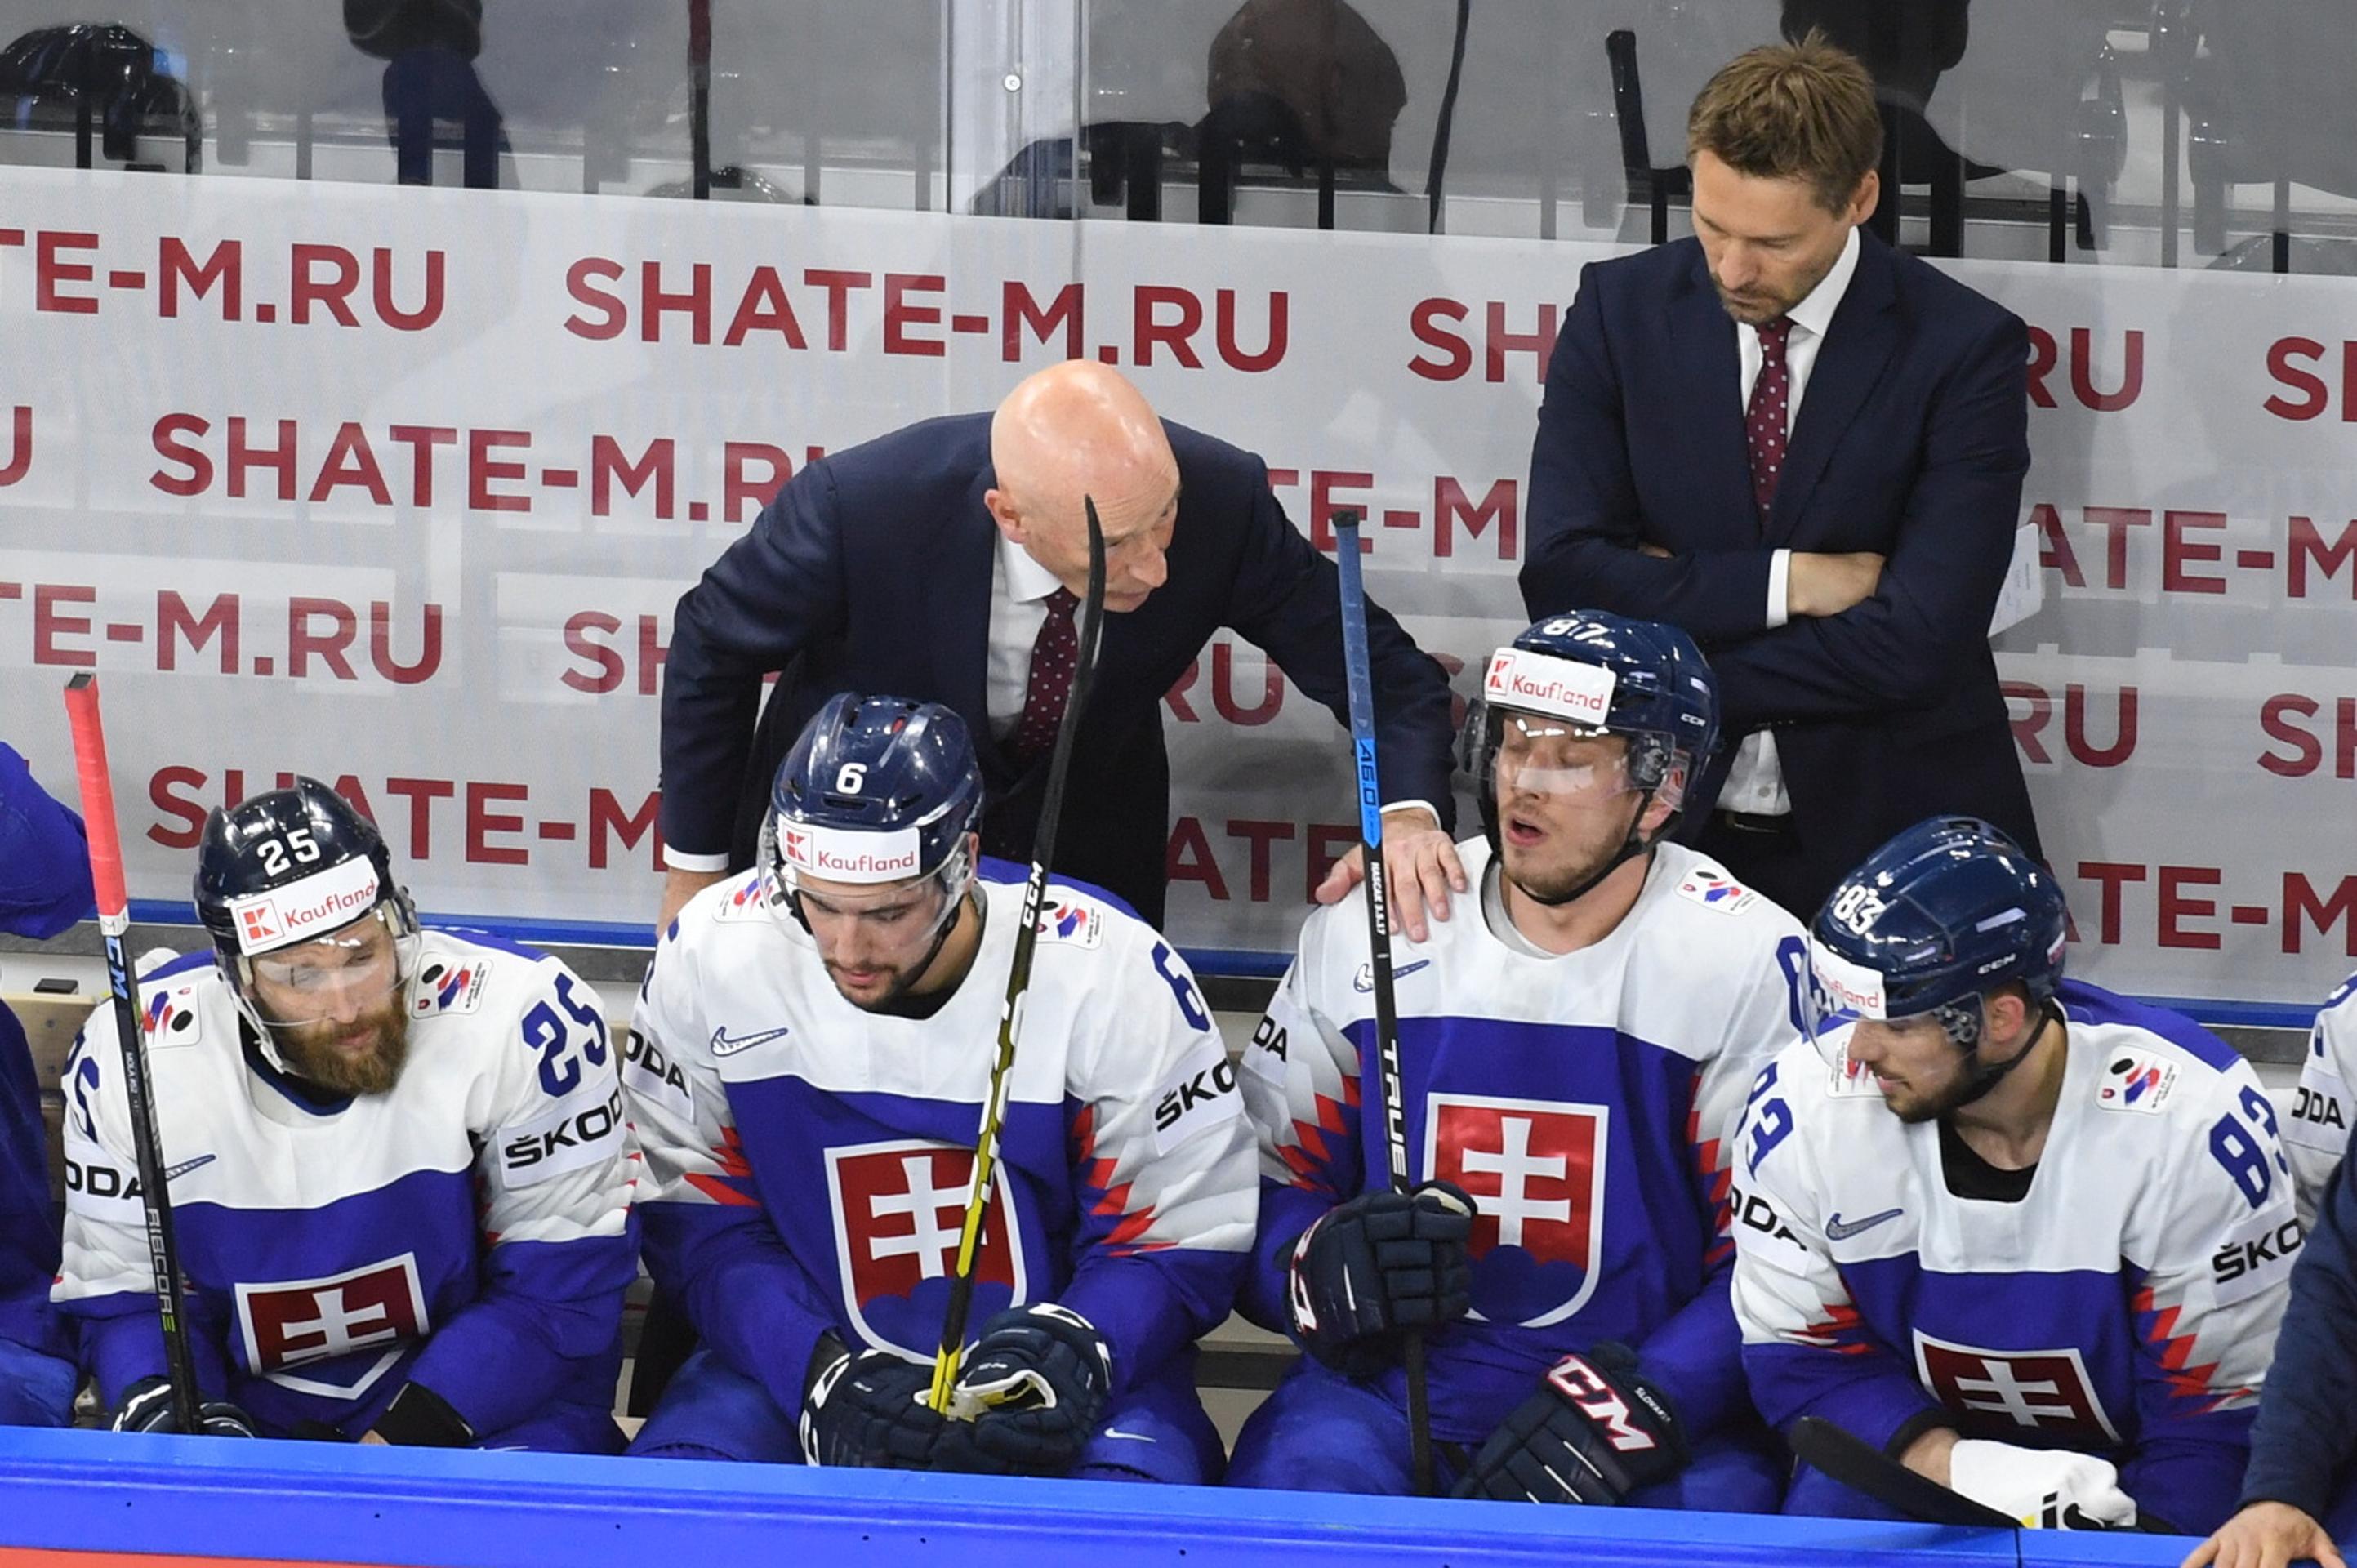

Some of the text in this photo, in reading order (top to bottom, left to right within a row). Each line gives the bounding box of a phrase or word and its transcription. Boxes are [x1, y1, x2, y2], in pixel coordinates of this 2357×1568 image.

[564, 257, 1289, 372] SHATE-M.RU
[149, 412, 825, 523] SHATE-M.R
[1543, 618, 1611, 641] 87
[1512, 673, 1605, 711] Kaufland
[835, 762, 868, 795] 6
[256, 827, 321, 878] 25
[818, 850, 915, 872] Kaufland
[283, 880, 376, 929] Kaufland
[1021, 860, 1045, 929] CCM
[1833, 884, 1887, 936] 83
[1151, 940, 1211, 1033] 6
[521, 971, 608, 1098] 25
[1383, 1038, 1408, 1178] TRUE
